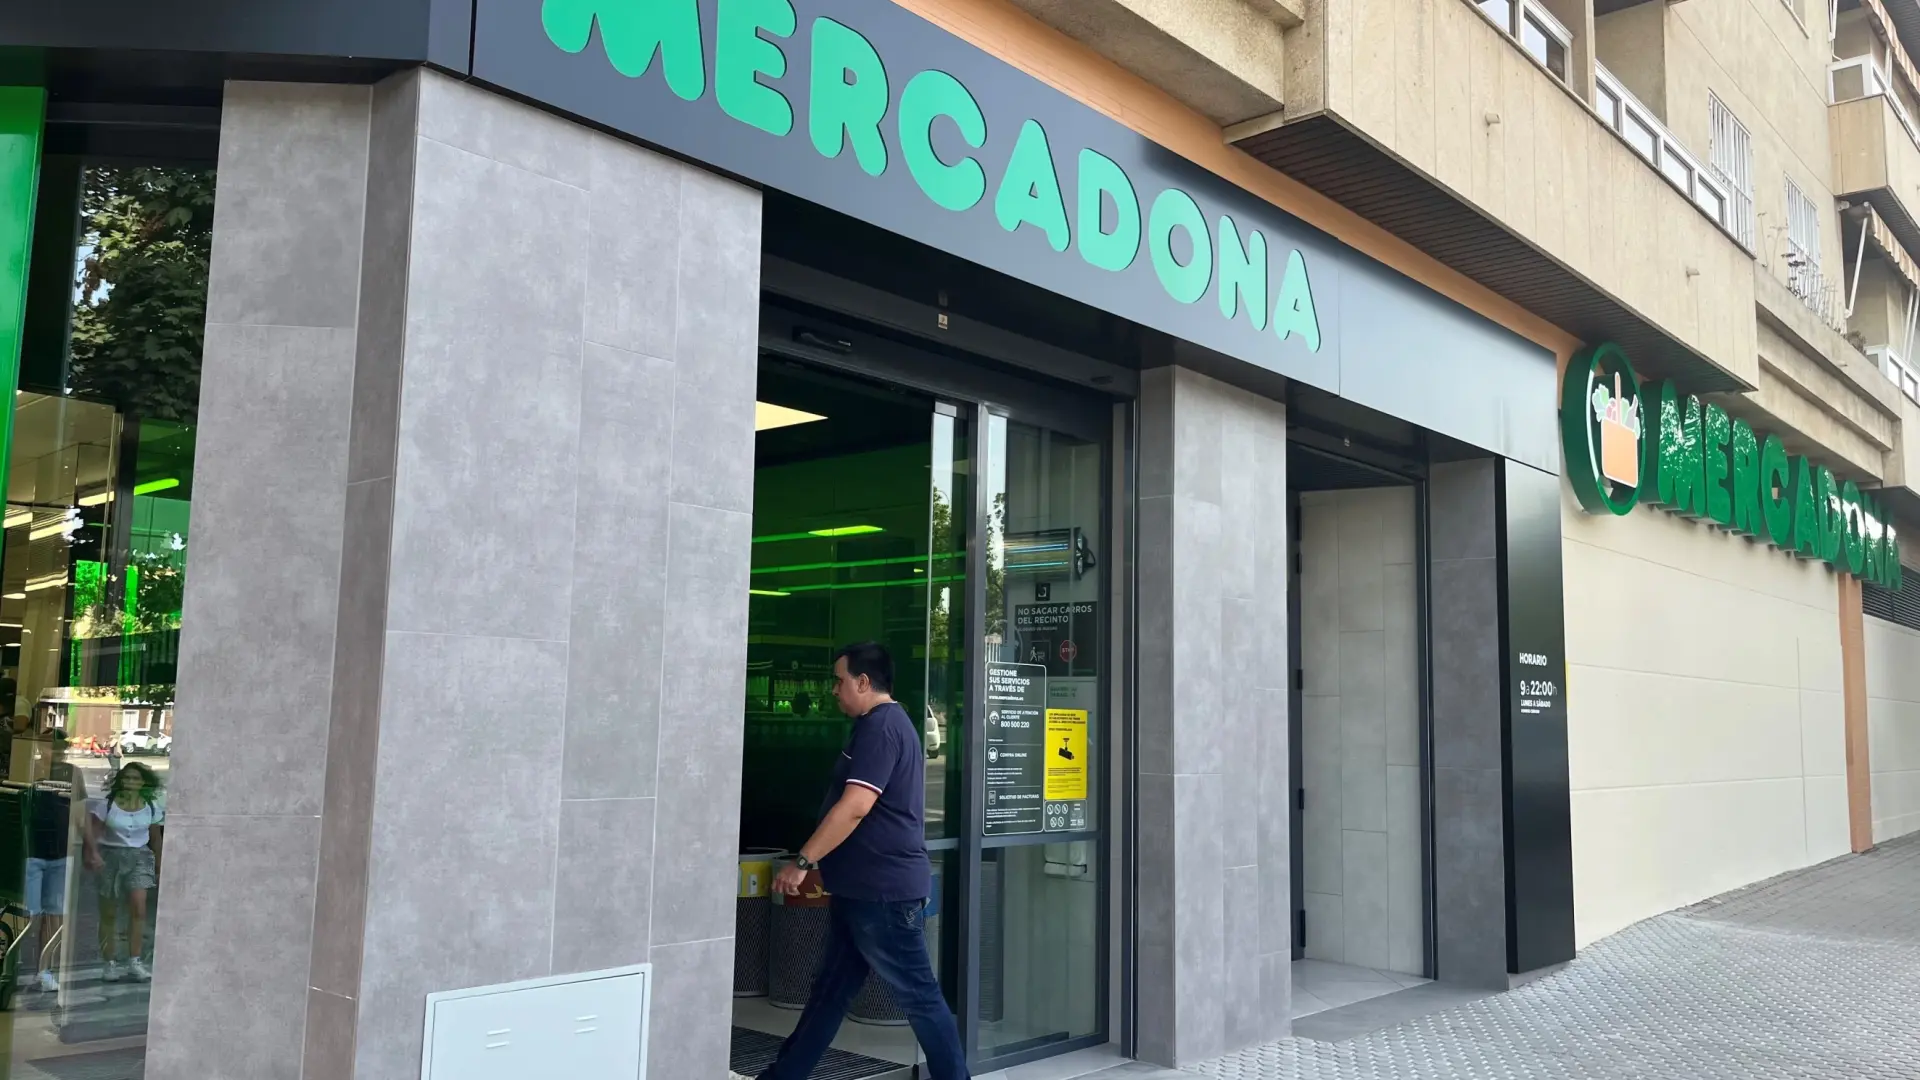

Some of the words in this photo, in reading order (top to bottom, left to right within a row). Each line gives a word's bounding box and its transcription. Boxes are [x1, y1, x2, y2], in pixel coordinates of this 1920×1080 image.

[1657, 377, 1902, 591] MERCADONA
[1017, 607, 1030, 615] NO
[1031, 606, 1058, 615] SACAR
[1060, 605, 1092, 614] CARROS
[1017, 617, 1032, 625] DEL
[1034, 615, 1069, 624] RECINTO
[1519, 652, 1547, 667] HORARIO
[988, 668, 1018, 677] GESTIONE
[988, 676, 1001, 684] SUS
[1001, 677, 1030, 686] SERVICIOS
[988, 684, 994, 692] A
[994, 684, 1017, 693] TRAVÉS
[1016, 685, 1025, 693] DE
[1000, 720, 1010, 728] 800
